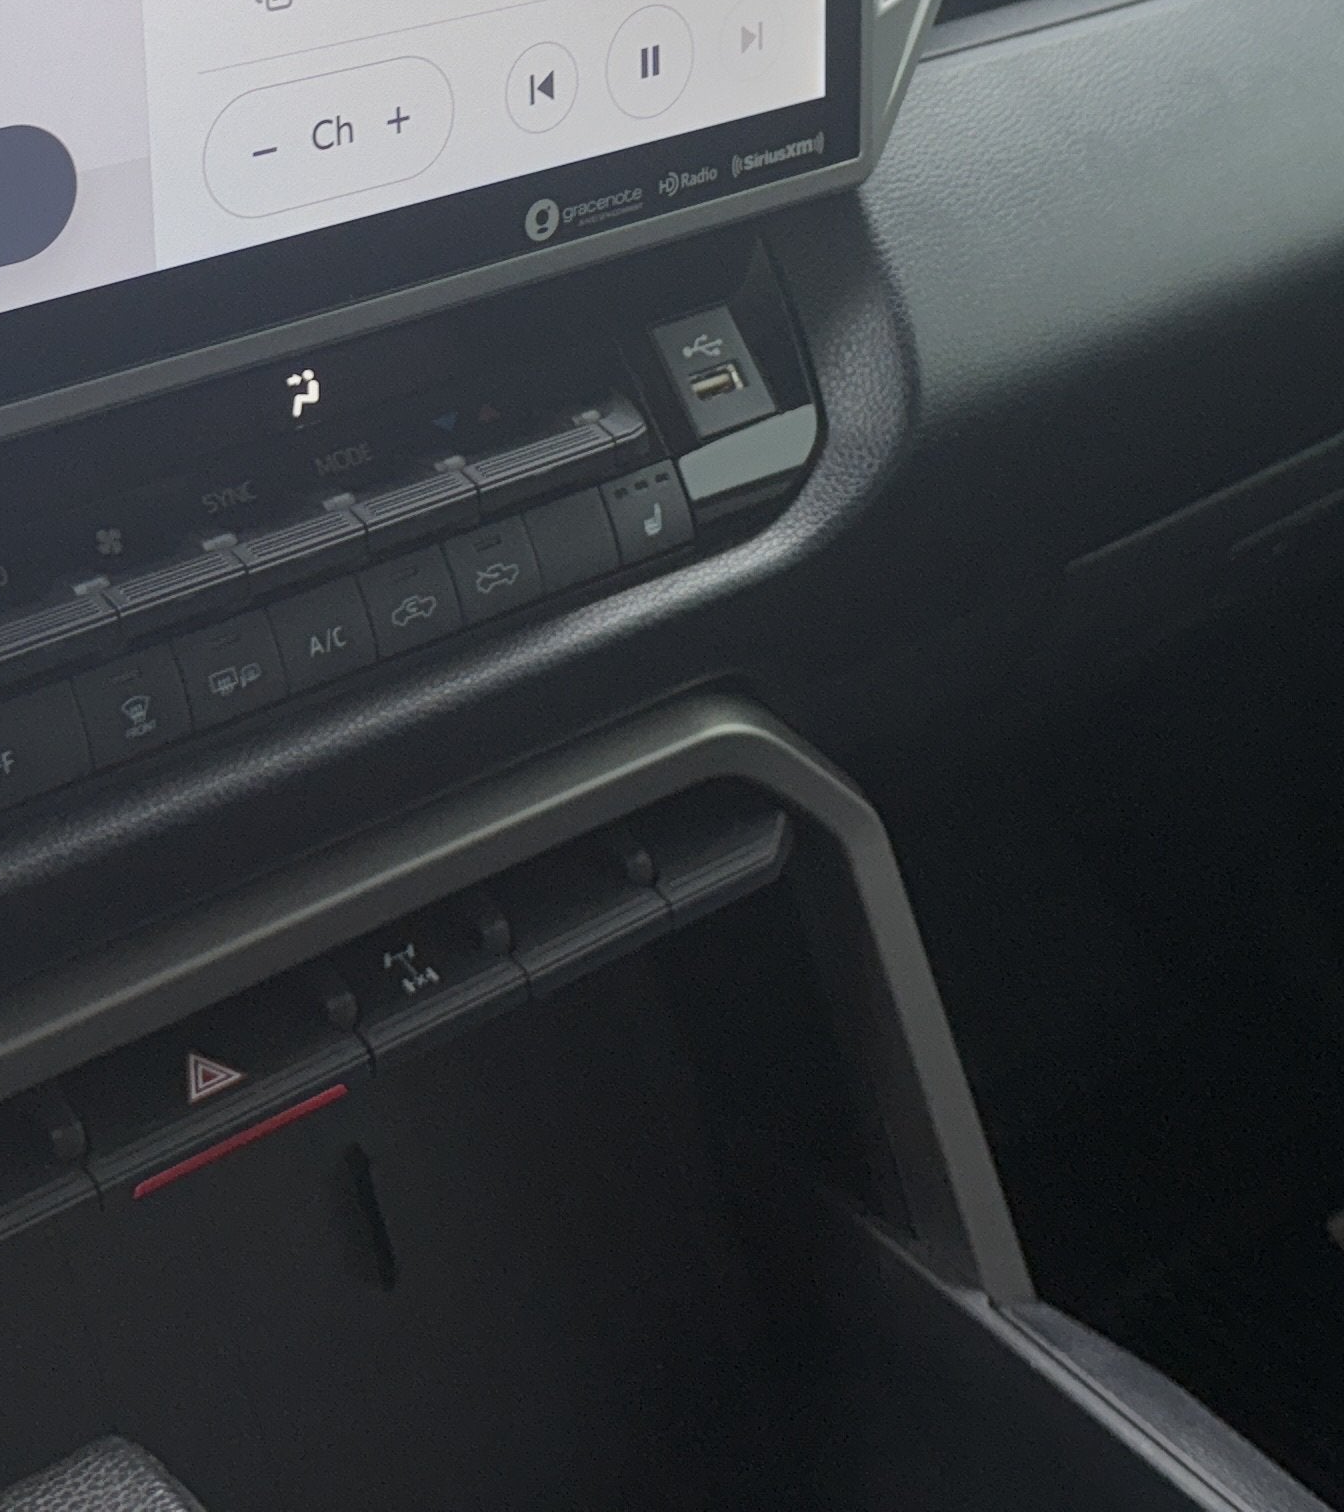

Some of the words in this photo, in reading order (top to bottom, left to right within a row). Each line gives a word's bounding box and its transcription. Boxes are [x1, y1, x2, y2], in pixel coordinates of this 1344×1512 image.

[312, 116, 355, 152] Ch
[681, 167, 718, 188] Radio
[563, 187, 643, 224] gracenote
[315, 441, 372, 476] MODE
[310, 626, 346, 657] A/C
